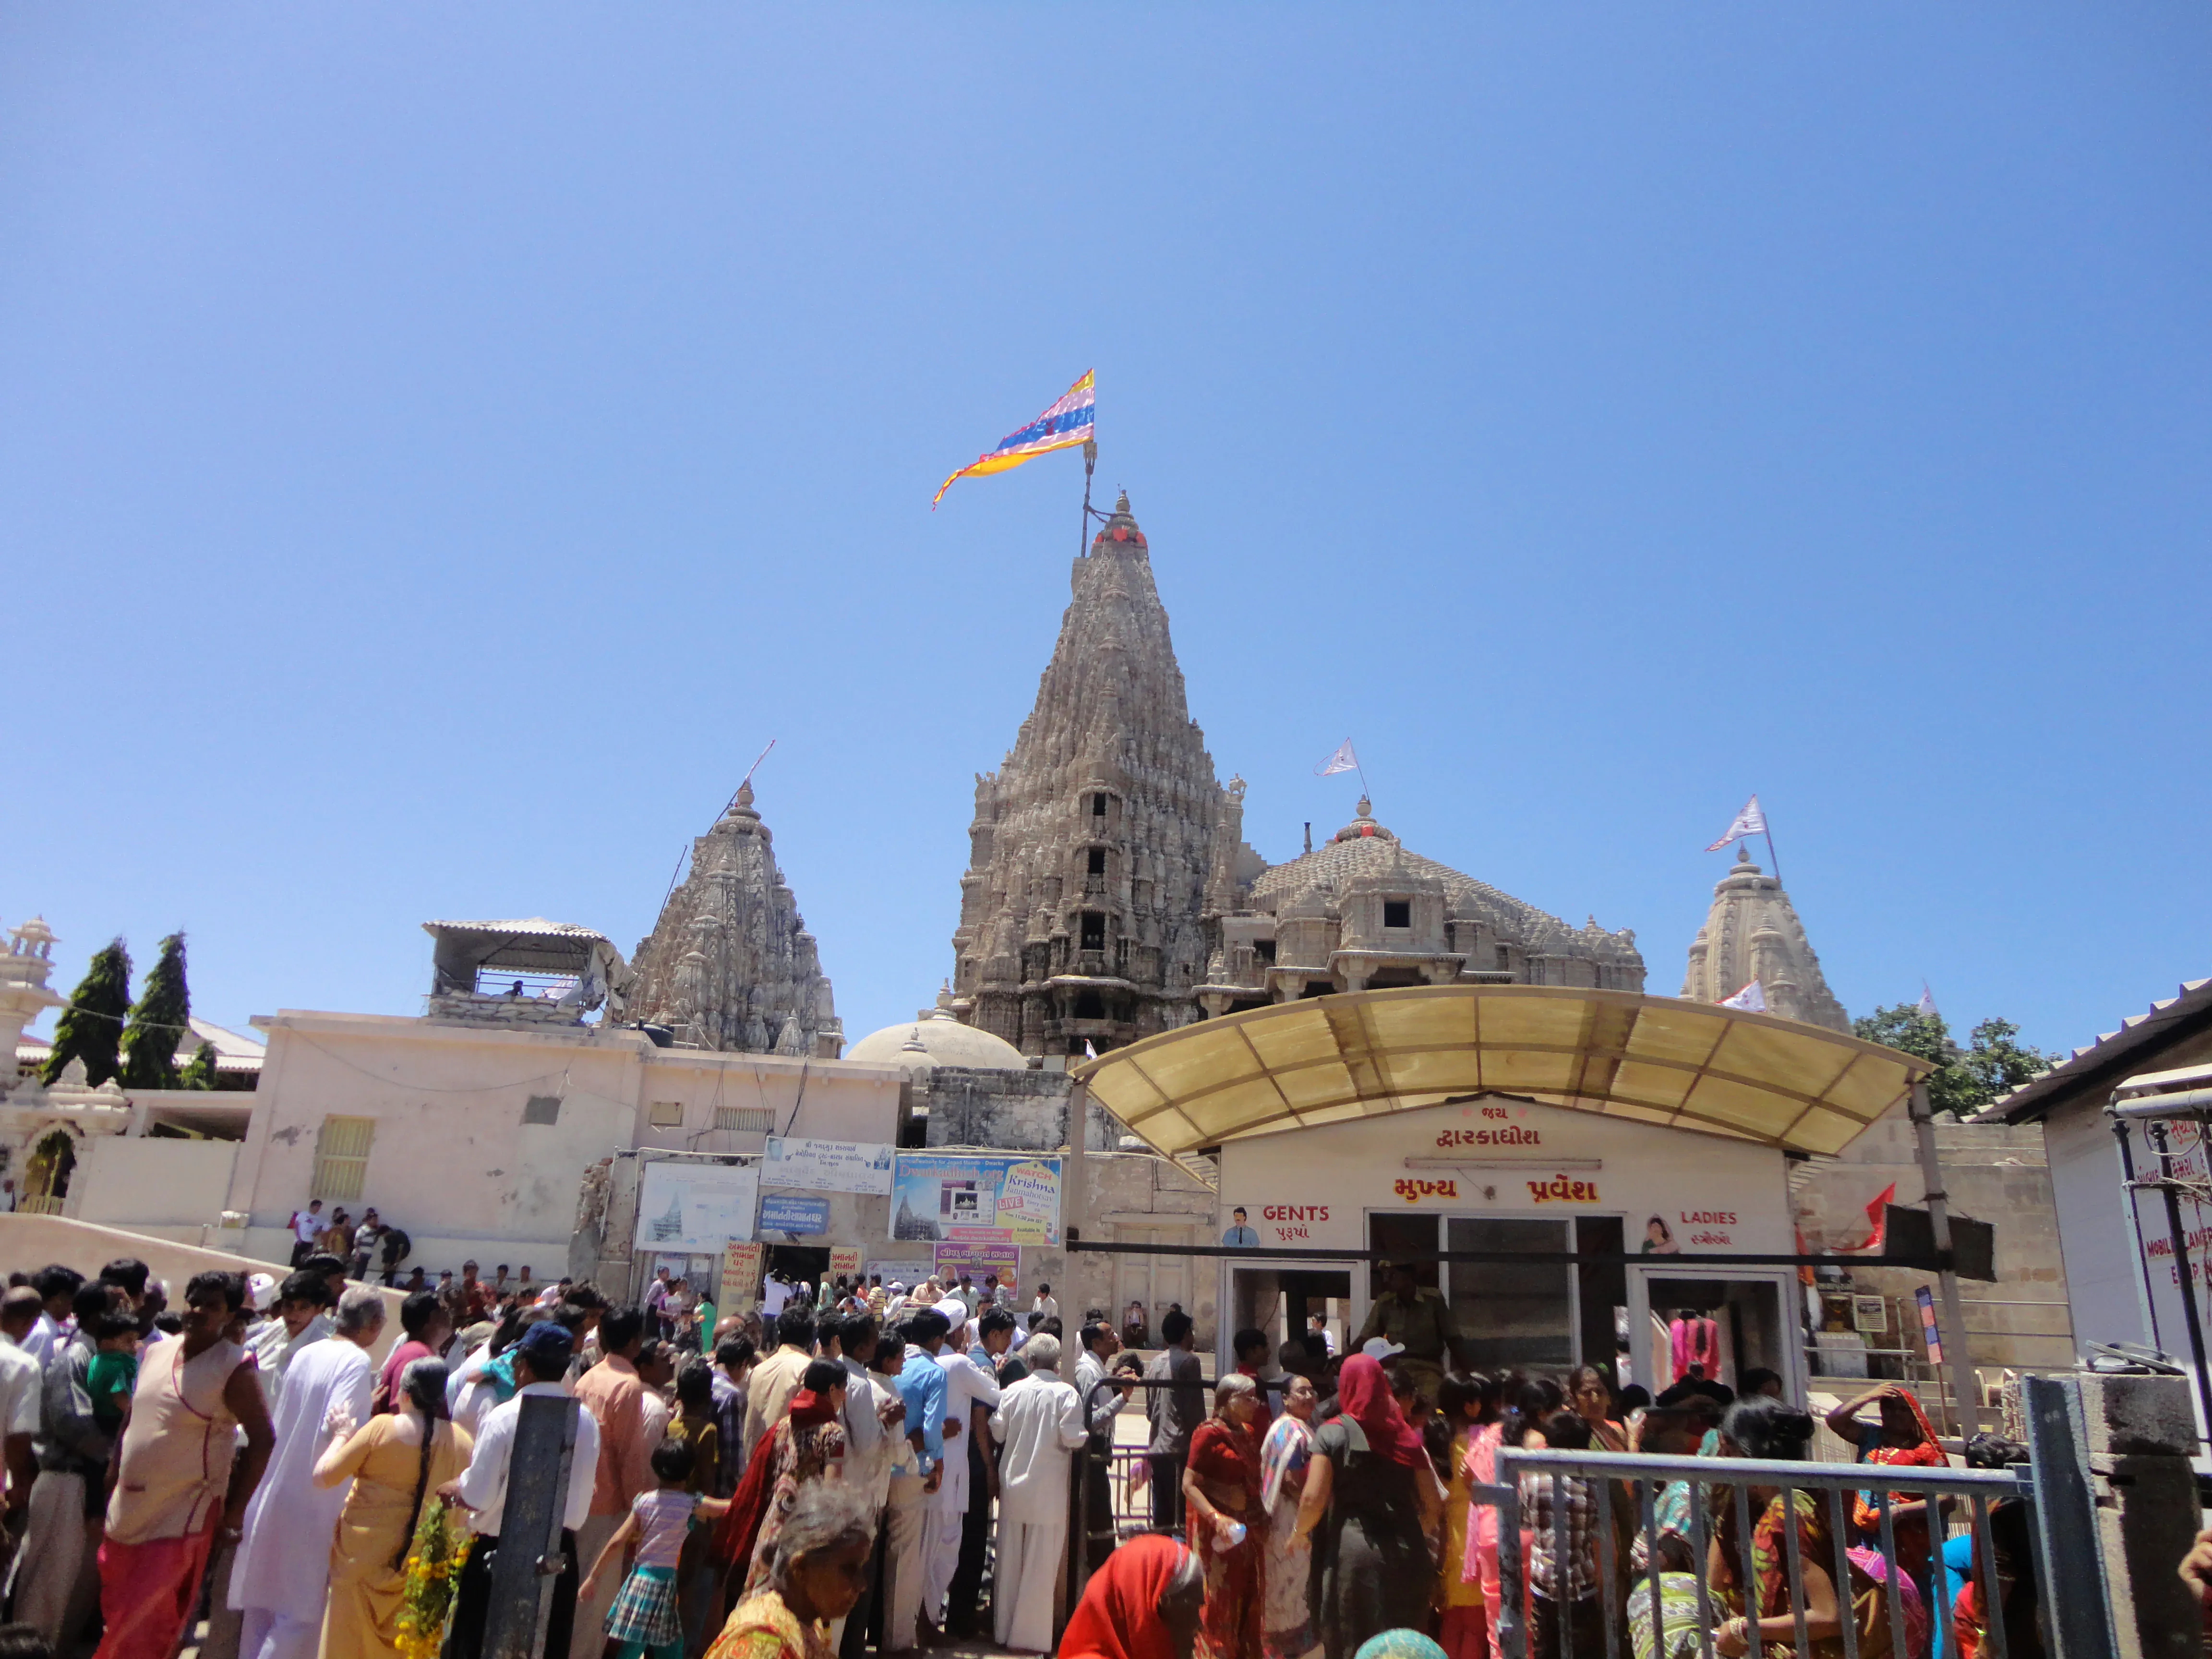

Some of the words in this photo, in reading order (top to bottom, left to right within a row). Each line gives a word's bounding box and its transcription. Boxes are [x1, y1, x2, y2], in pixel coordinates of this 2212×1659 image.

[1481, 1107, 1508, 1119] જય
[1436, 1125, 1540, 1147] દ્વારકાધીશ
[899, 1164, 1004, 1182] Dwarkadhish.org
[1016, 1166, 1052, 1180] WATCH
[1009, 1174, 1055, 1193] Krishna
[1394, 1178, 1458, 1203] મુખ્ય
[1527, 1174, 1599, 1203] પ્રવેશ
[1006, 1185, 1054, 1202] Janmahotsav
[999, 1198, 1022, 1209] LIVE
[1263, 1206, 1329, 1221] GENTS
[1680, 1211, 1737, 1225] LADIES
[732, 1251, 755, 1260] સામાન
[831, 1252, 857, 1261] અમાનતી
[833, 1262, 855, 1270] સામાન
